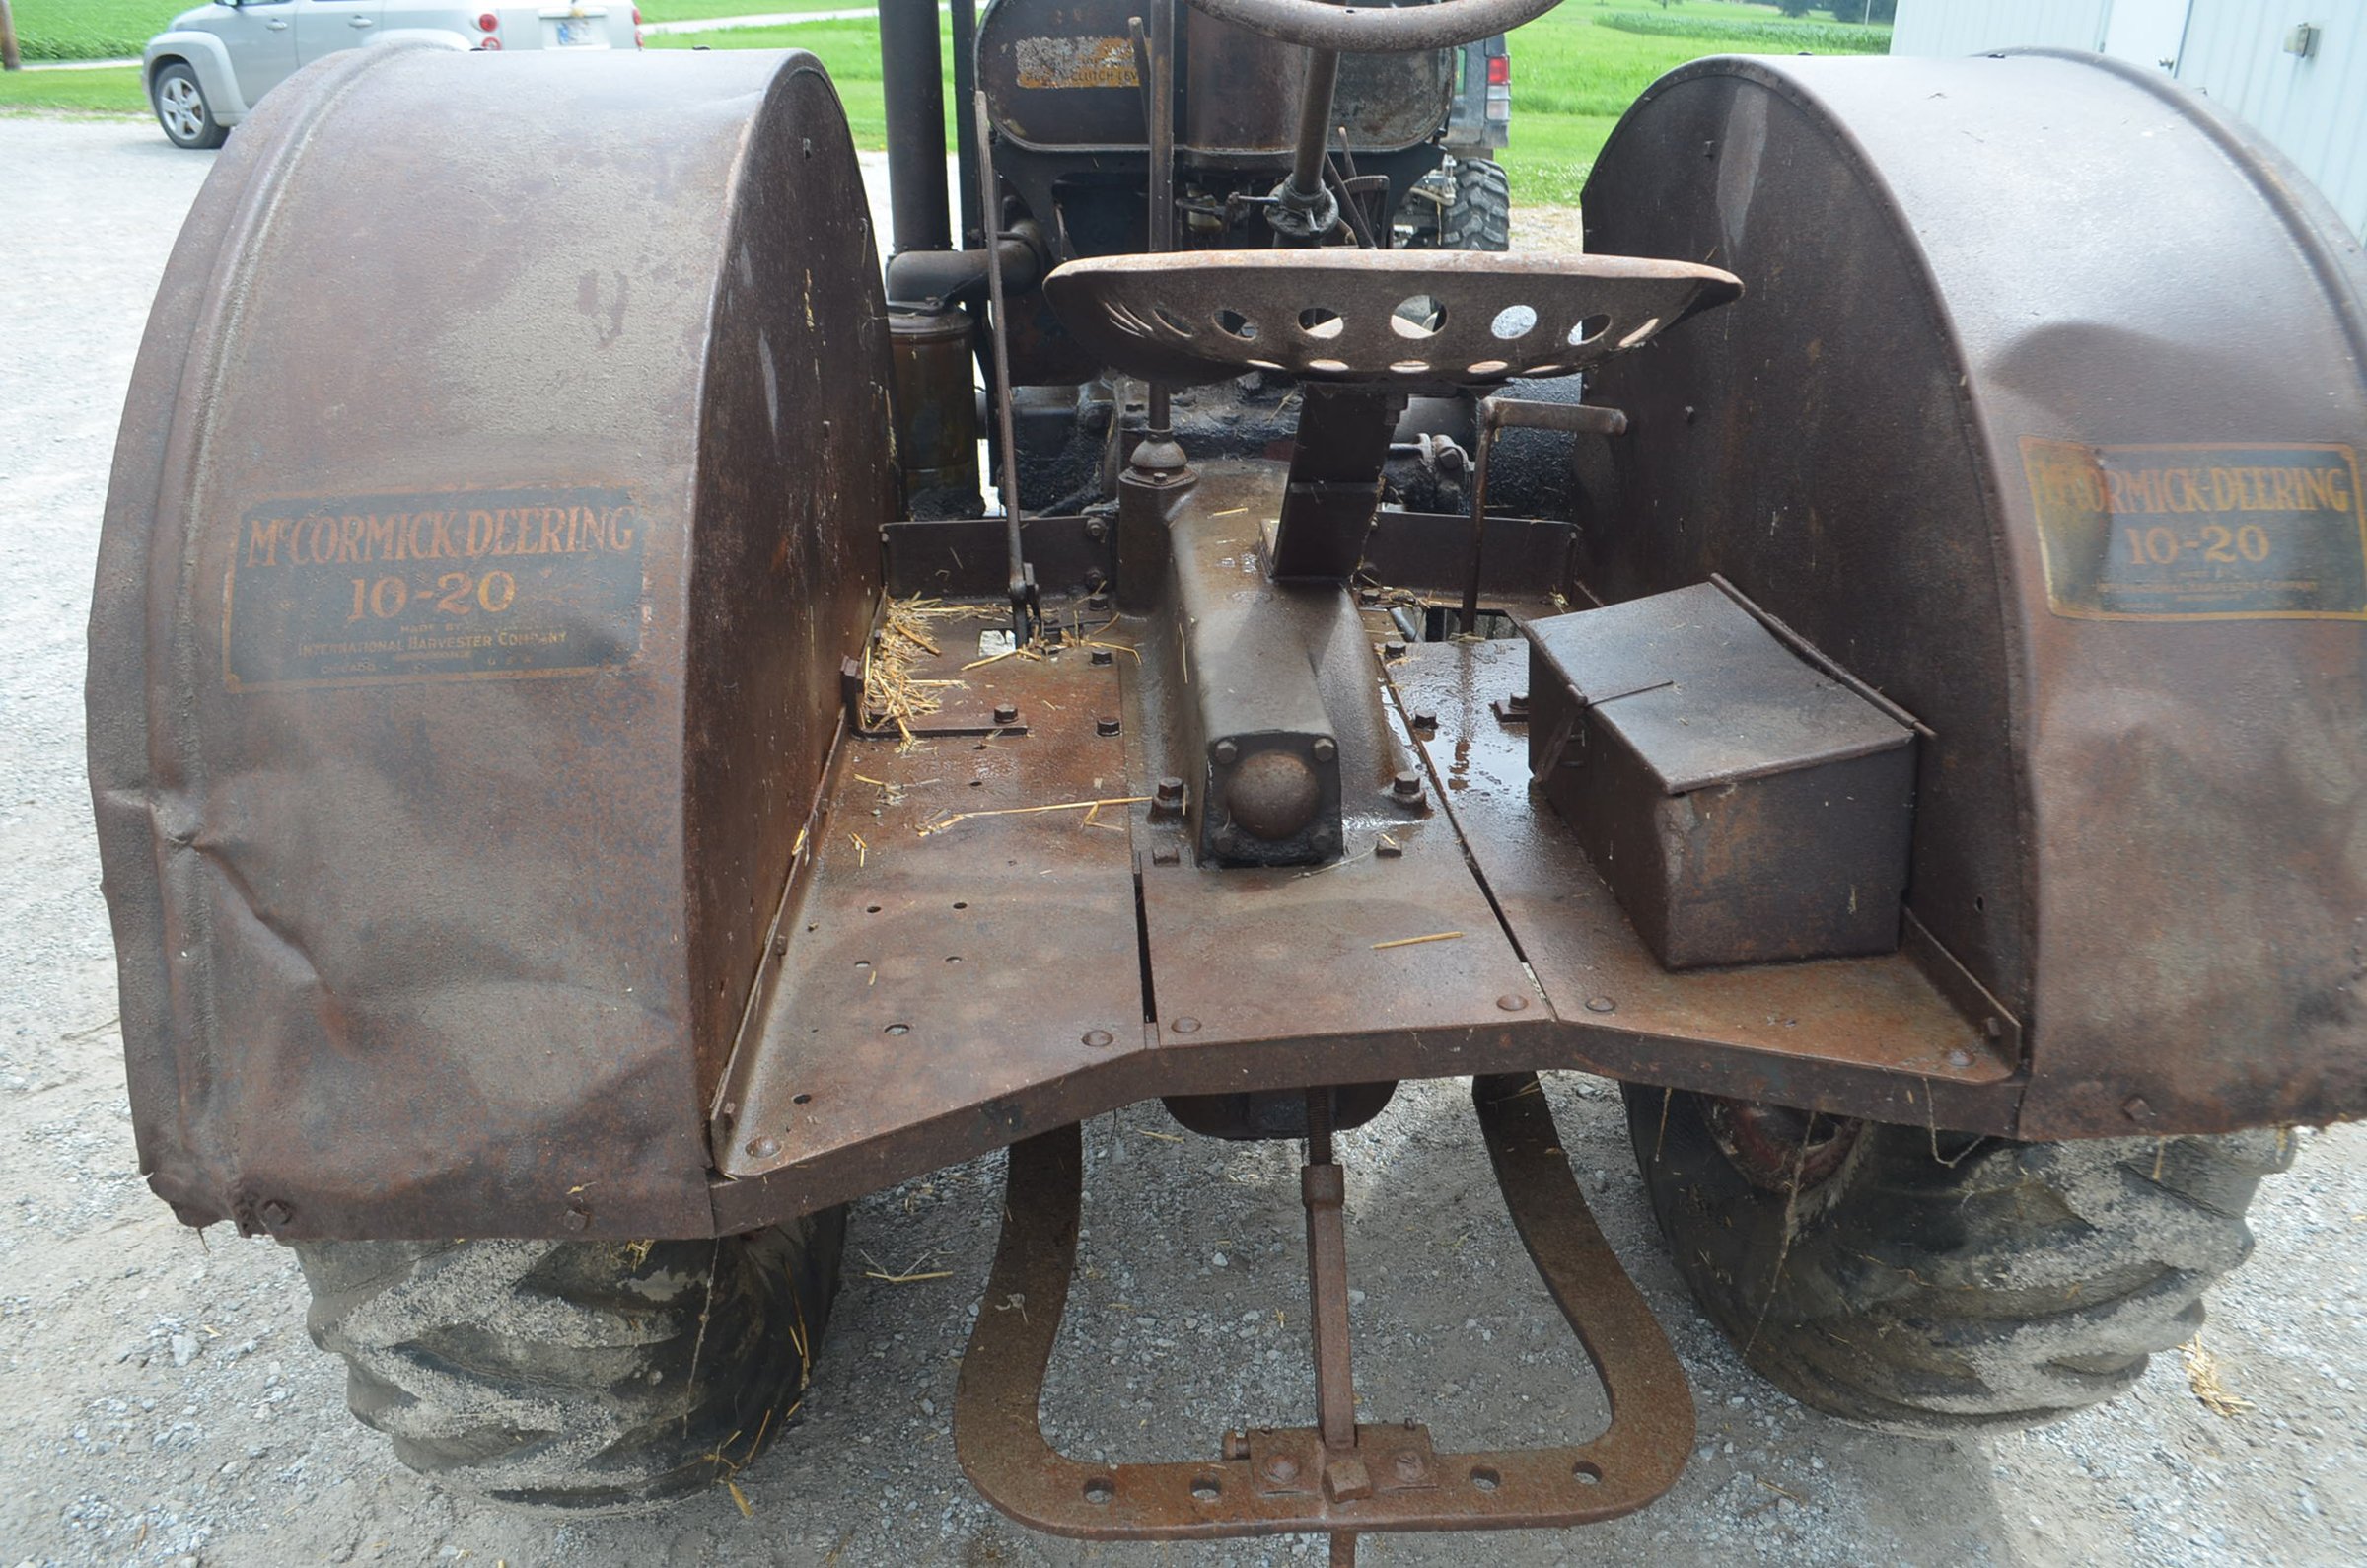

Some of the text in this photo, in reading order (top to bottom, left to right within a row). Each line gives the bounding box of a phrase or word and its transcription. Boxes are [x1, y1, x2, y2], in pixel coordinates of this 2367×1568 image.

[2126, 524, 2270, 566] 10-20
[348, 570, 516, 622] 10-20
[299, 639, 404, 658] INTERNATIONAL
[408, 634, 493, 651] HARVESTER
[497, 629, 567, 647] COMPANY
